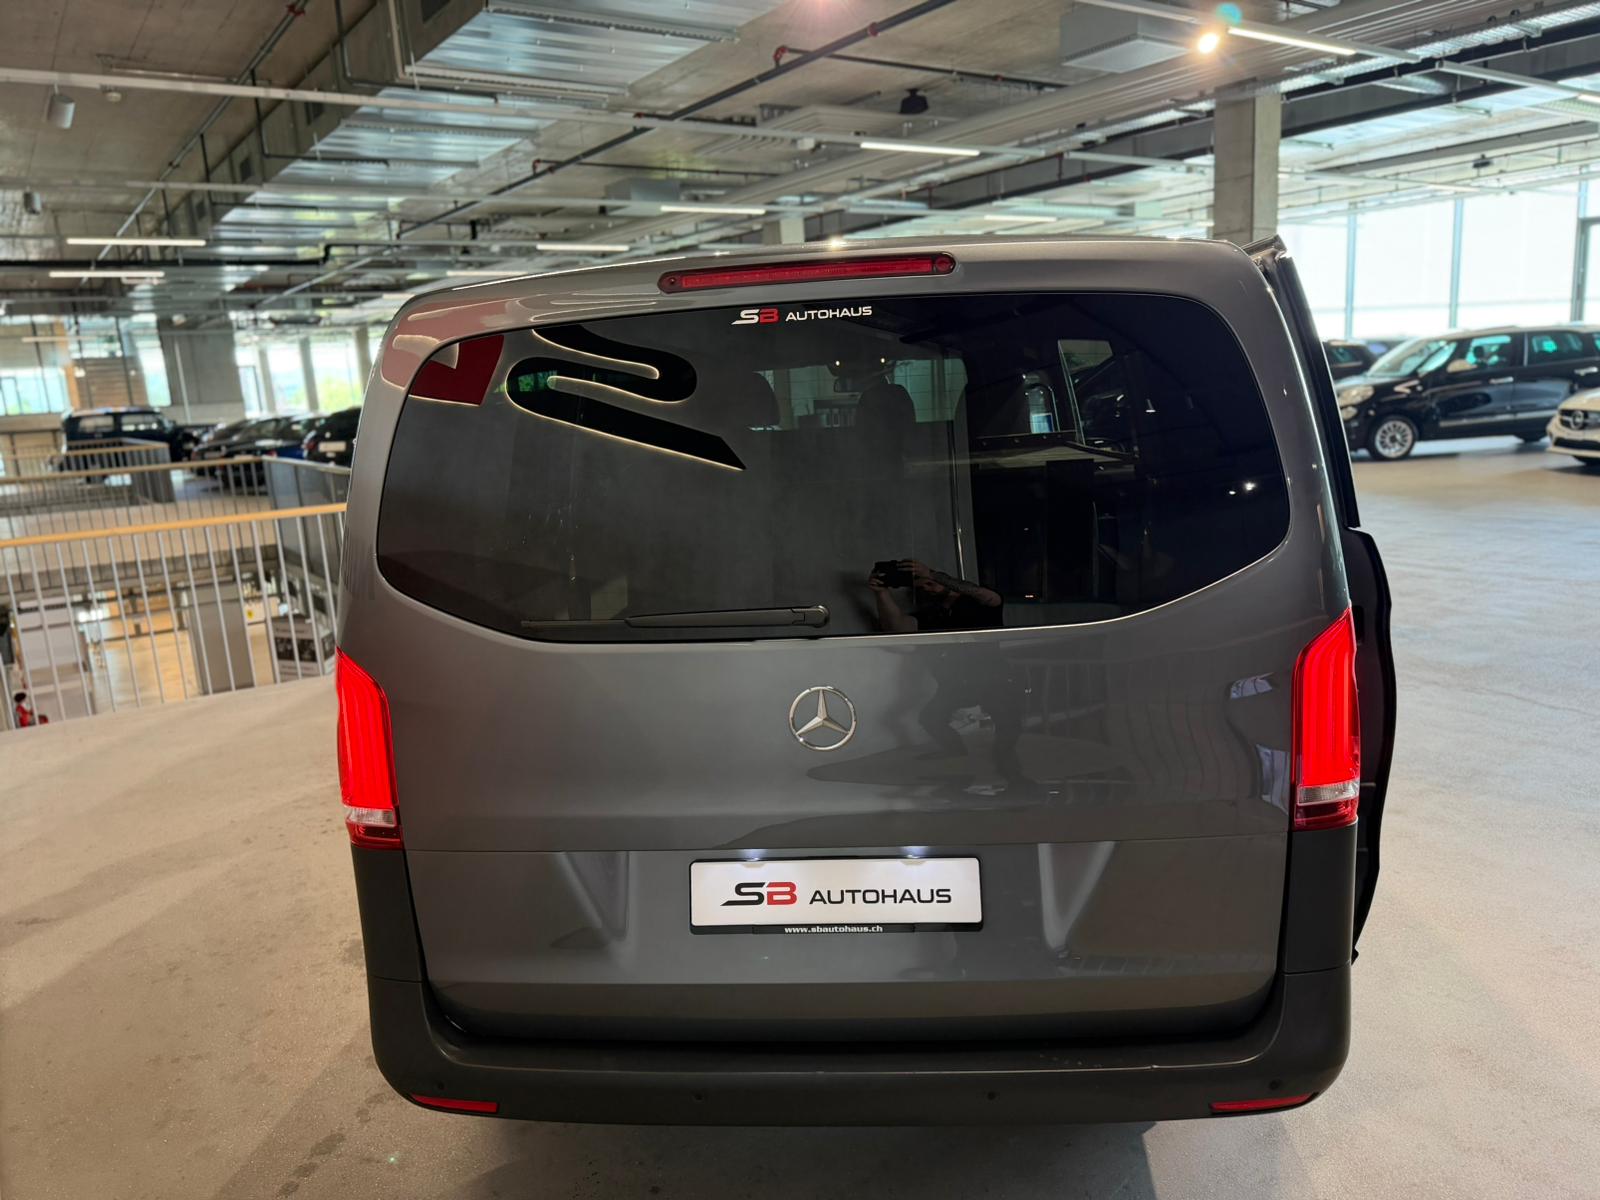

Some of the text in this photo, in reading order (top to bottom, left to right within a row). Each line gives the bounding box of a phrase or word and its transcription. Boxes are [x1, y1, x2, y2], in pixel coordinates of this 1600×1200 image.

[731, 306, 873, 325] SB AUTOHAUS
[720, 881, 951, 906] SB AUTOHAUS
[784, 925, 884, 934] www.sbautohaus.ch
